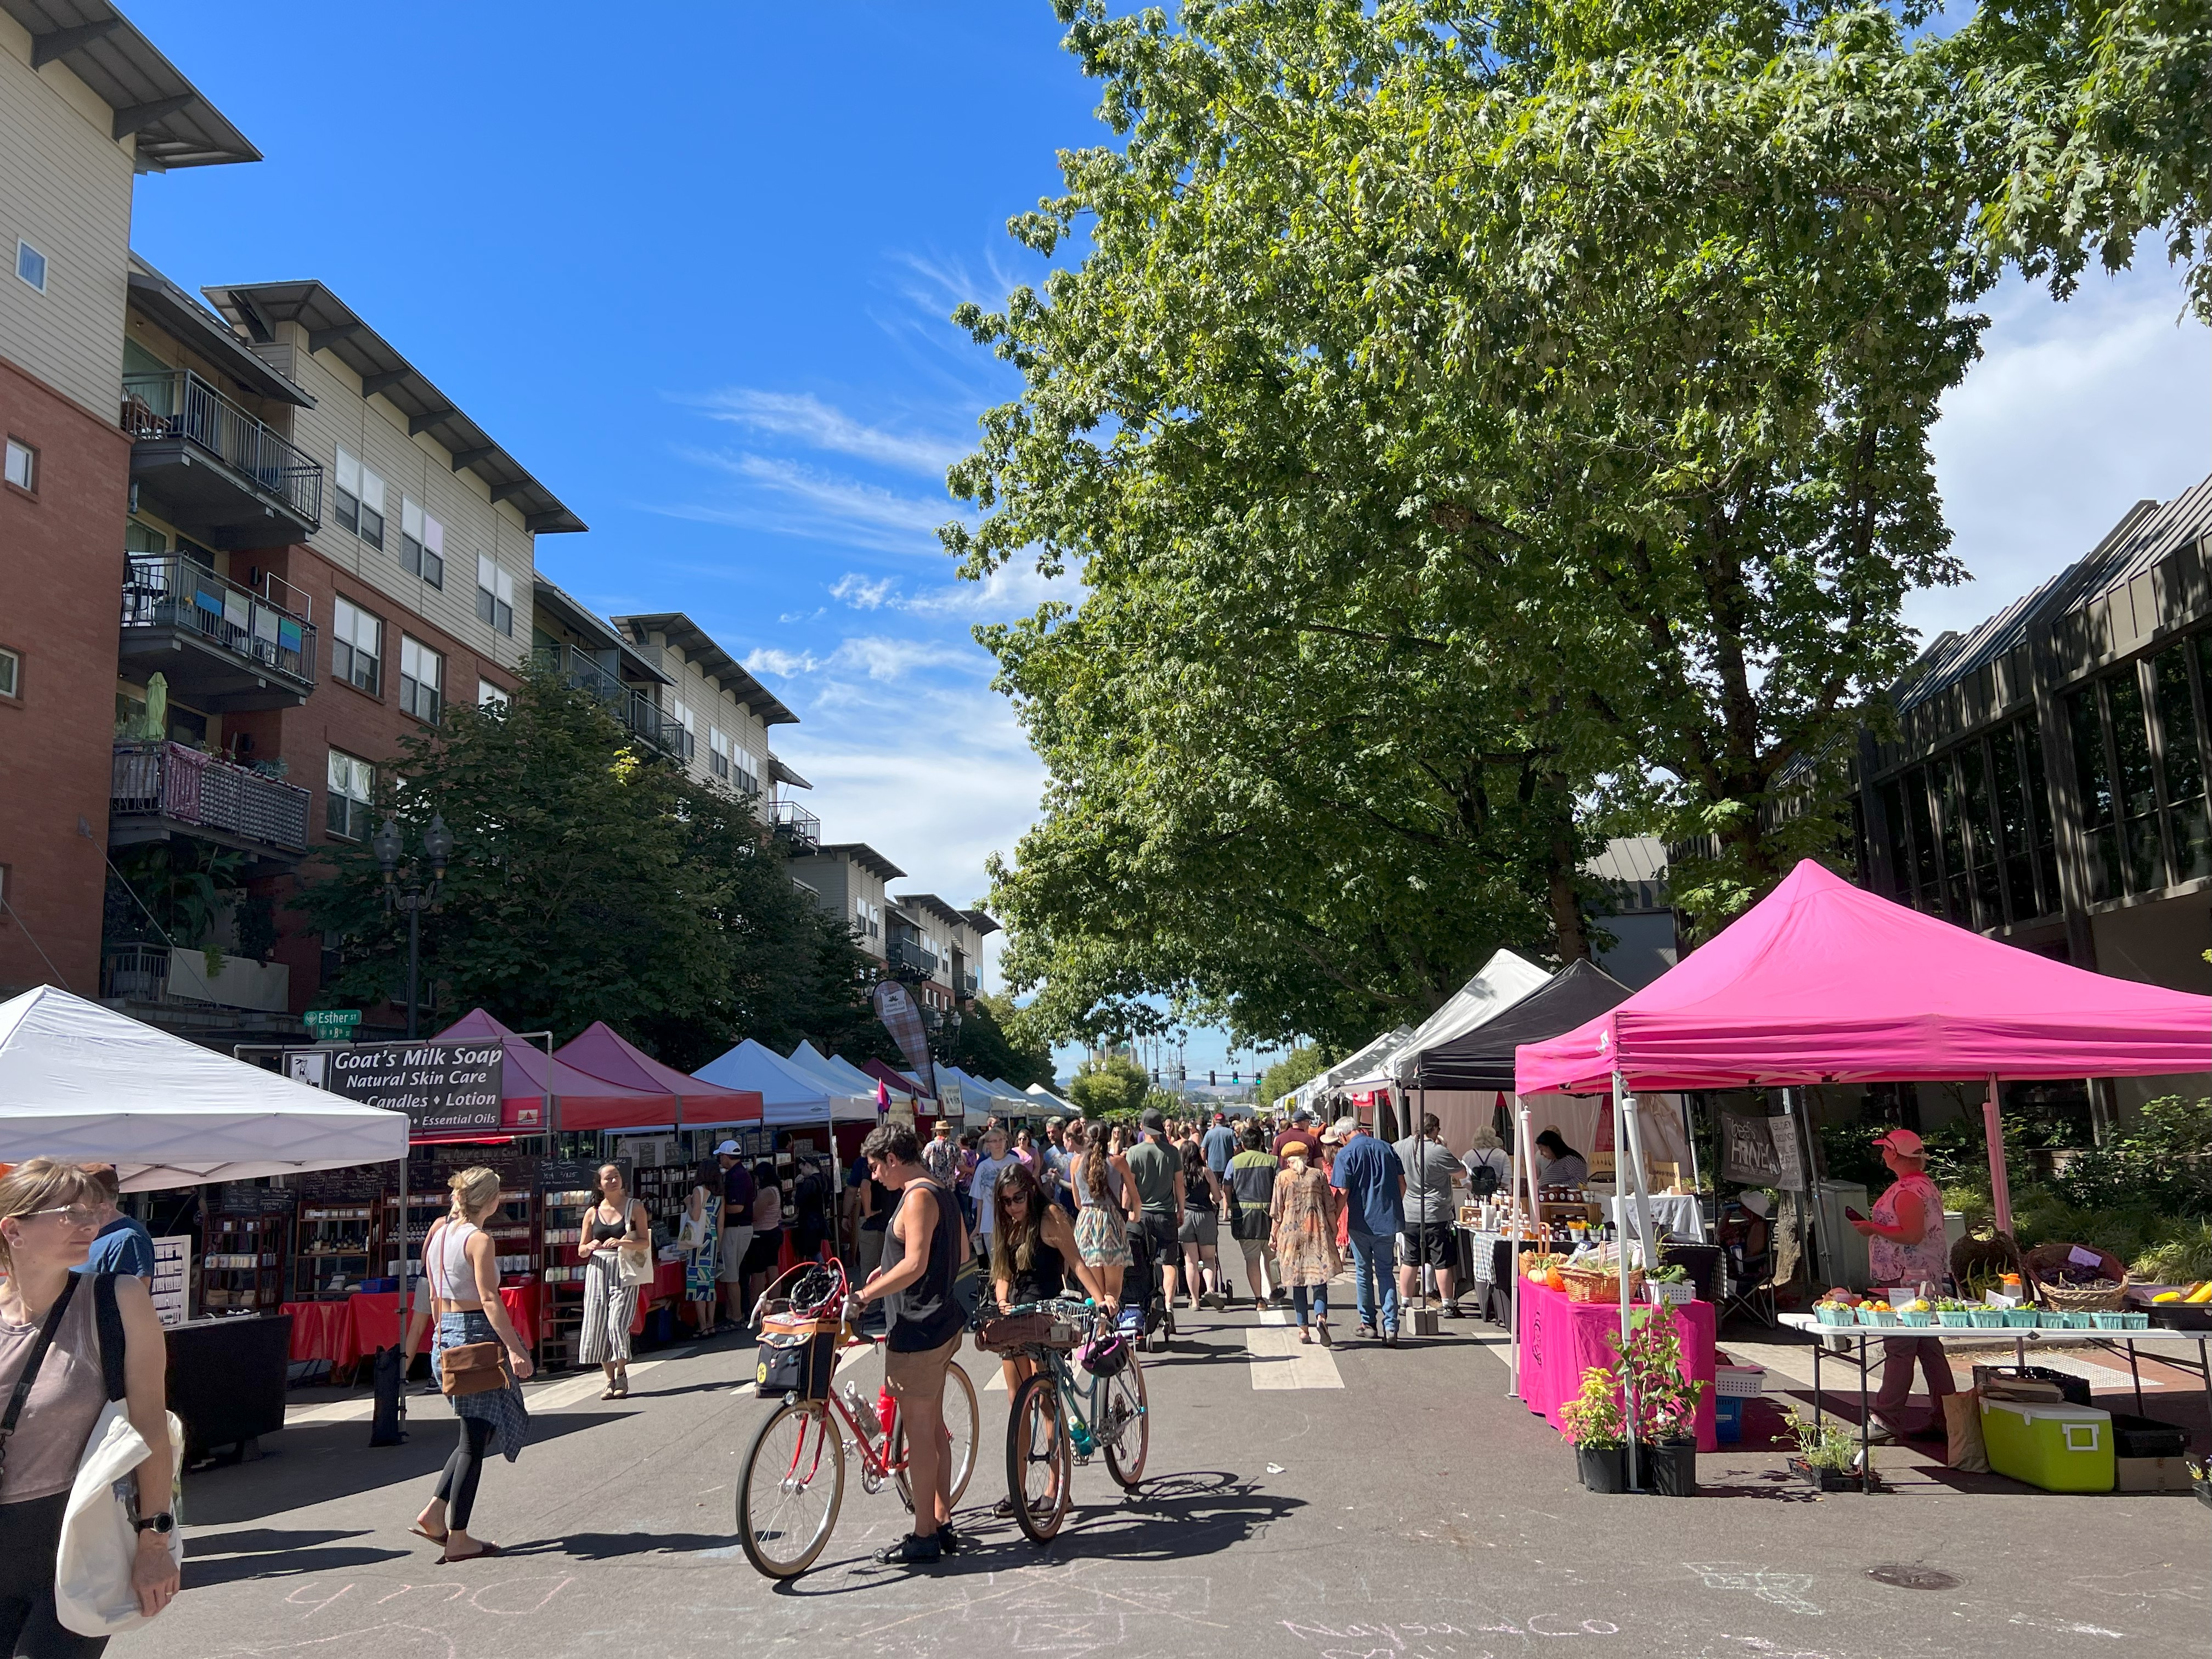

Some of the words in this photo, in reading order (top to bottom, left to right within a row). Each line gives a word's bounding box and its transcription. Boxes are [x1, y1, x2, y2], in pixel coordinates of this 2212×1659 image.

[318, 1011, 348, 1024] Esther
[335, 1050, 397, 1069] Goat's
[403, 1048, 446, 1066] Milk
[452, 1047, 503, 1066] Soap
[346, 1071, 406, 1088] Natural
[410, 1071, 444, 1086] Skin
[449, 1070, 487, 1084] Care
[366, 1094, 428, 1108] Candles
[446, 1092, 496, 1107] Lotion
[422, 1115, 471, 1126] Essential
[475, 1113, 495, 1124] Oils
